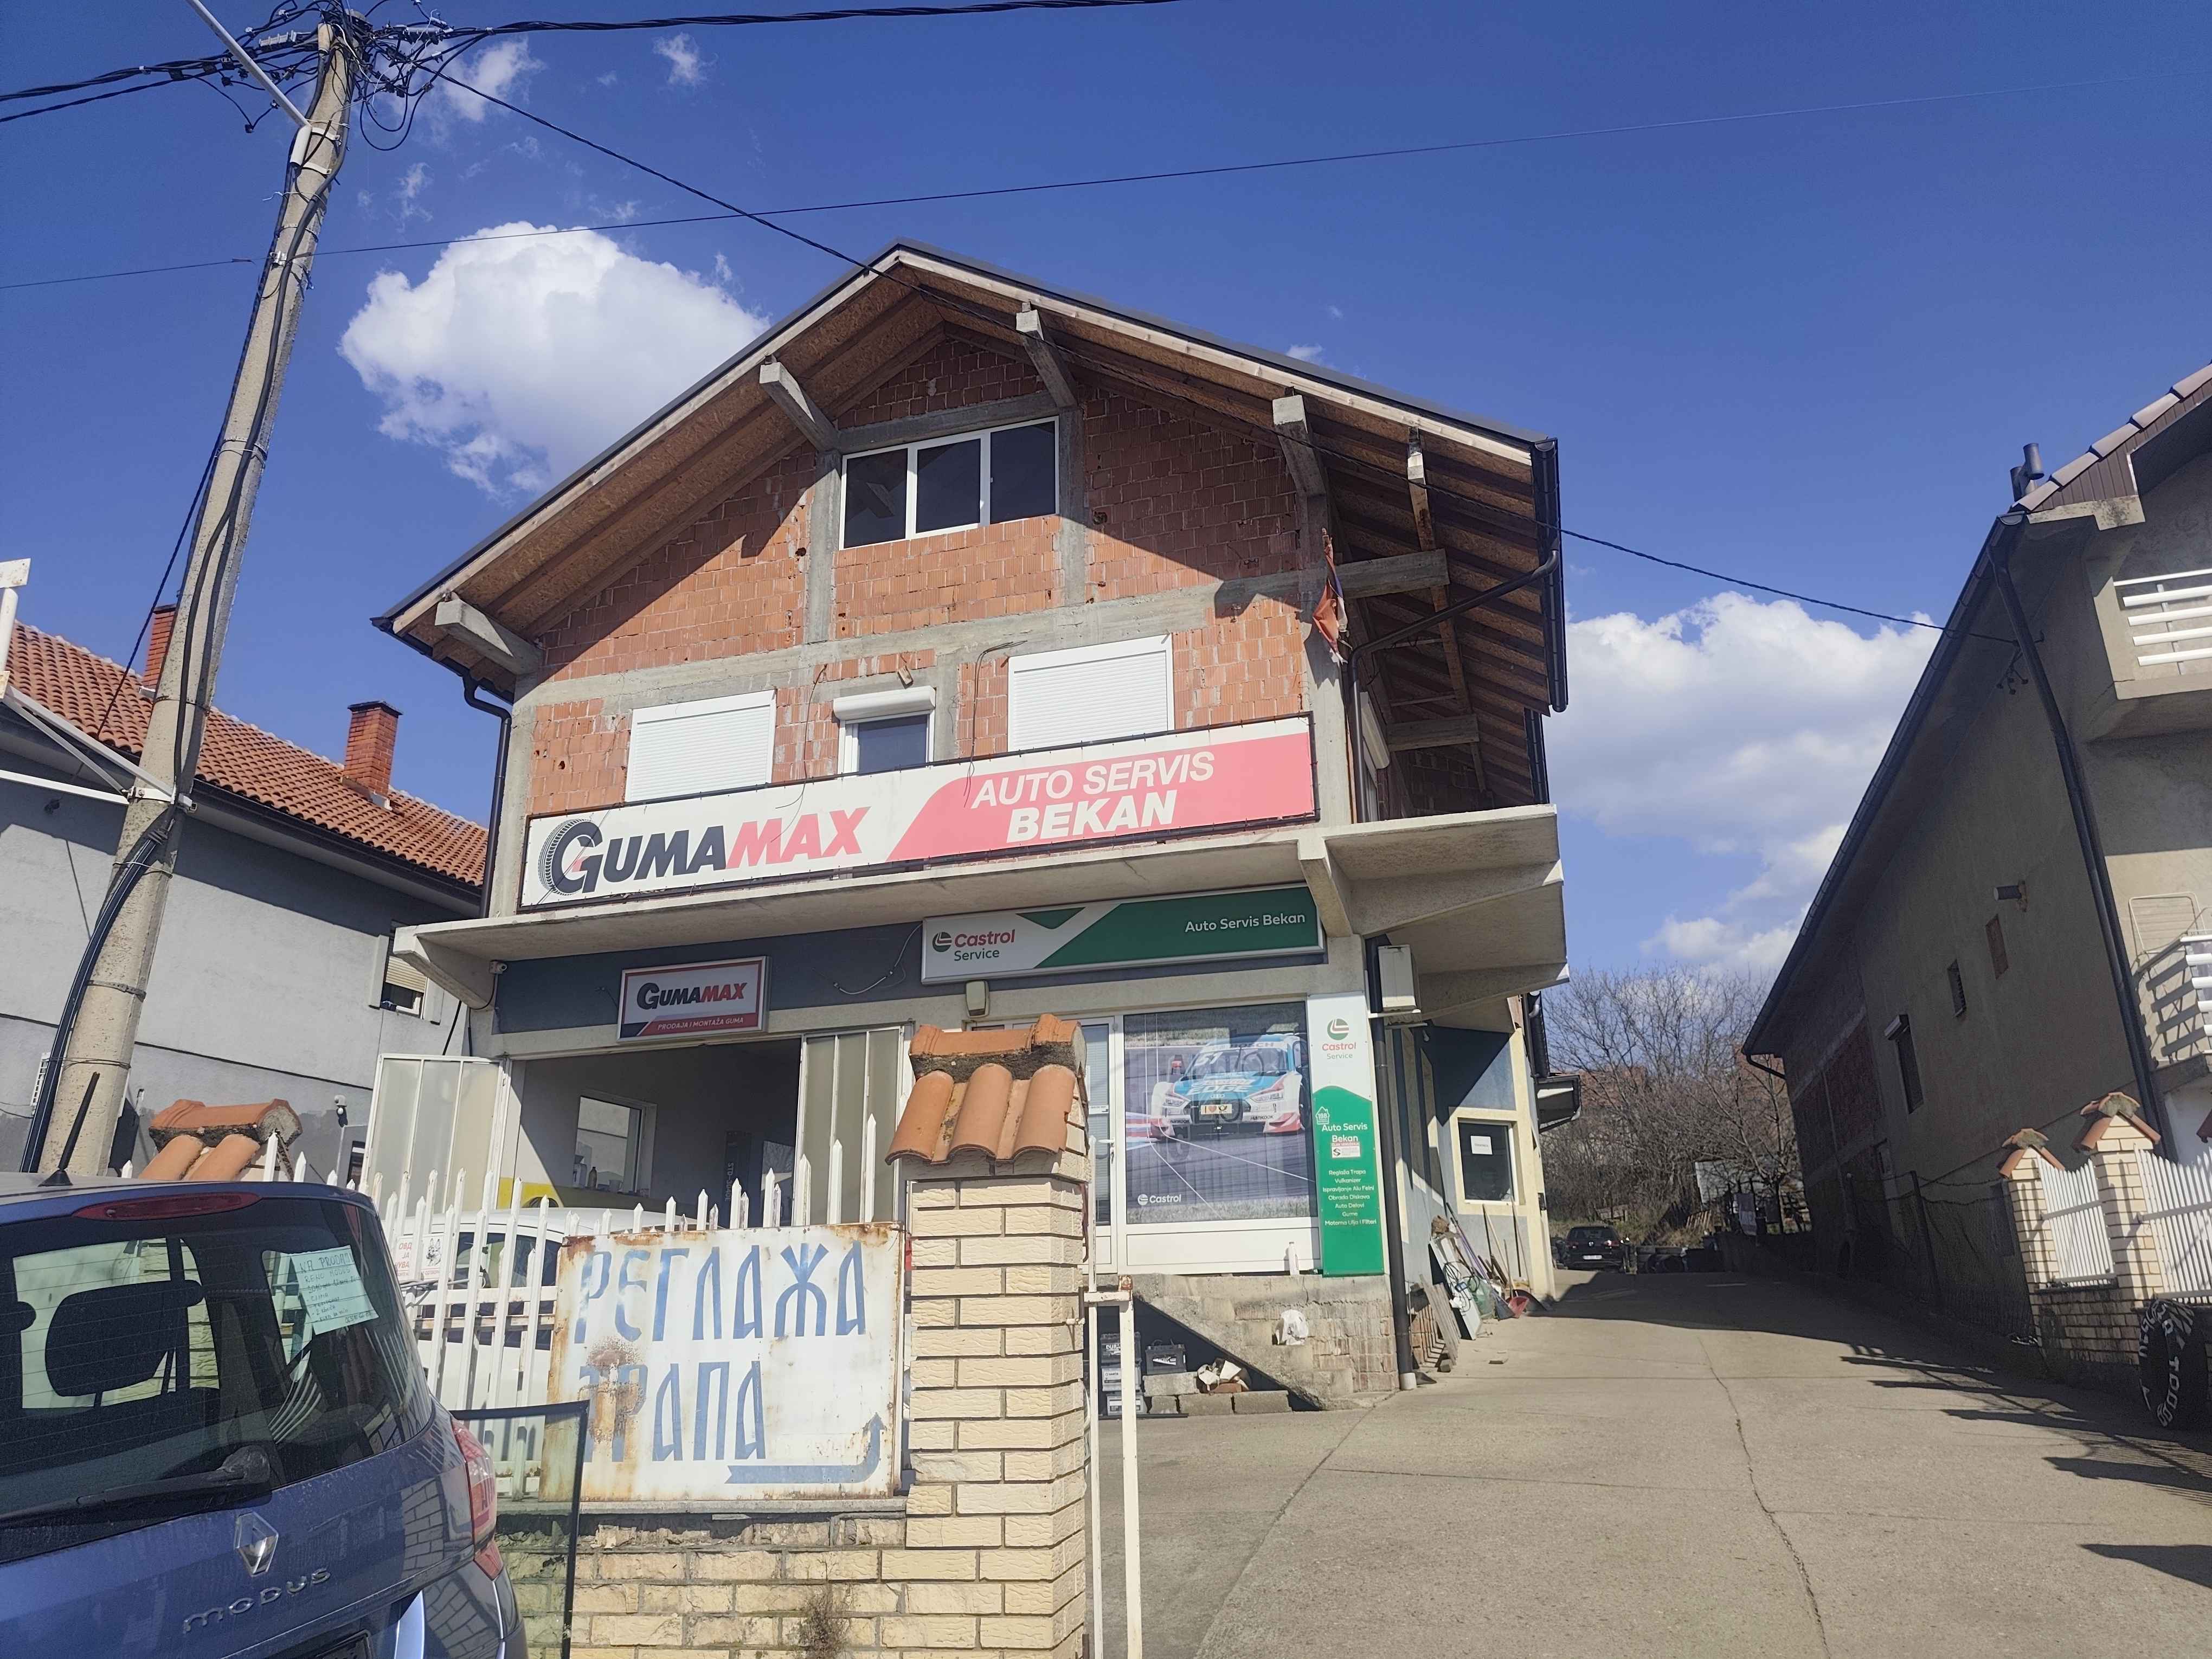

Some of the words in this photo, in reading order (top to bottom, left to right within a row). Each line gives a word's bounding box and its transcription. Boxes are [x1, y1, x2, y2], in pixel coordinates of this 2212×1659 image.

[971, 769, 1073, 809] AUTO
[1083, 751, 1215, 794] SERVIS
[1006, 789, 1178, 844] BEKAN
[540, 806, 871, 894] GUMAMAX
[1185, 921, 1217, 933] Auto
[1220, 916, 1259, 930] Servis
[1263, 912, 1306, 926] Bekan
[954, 929, 1015, 948] Castrol
[954, 948, 1000, 961] Service
[636, 982, 748, 1010] GUMAMAX
[657, 1022, 689, 1031] PRODAJA
[693, 1018, 724, 1028] MONTAŽA
[1322, 1041, 1356, 1051] Castrol
[1187, 1084, 1253, 1096] EDGE
[1322, 1124, 1341, 1132] Auto
[1343, 1122, 1368, 1131] Servis
[1332, 1134, 1359, 1143] Bekan
[1149, 1194, 1182, 1204] Castrol
[574, 1240, 866, 1344] РЕГЛАЖА
